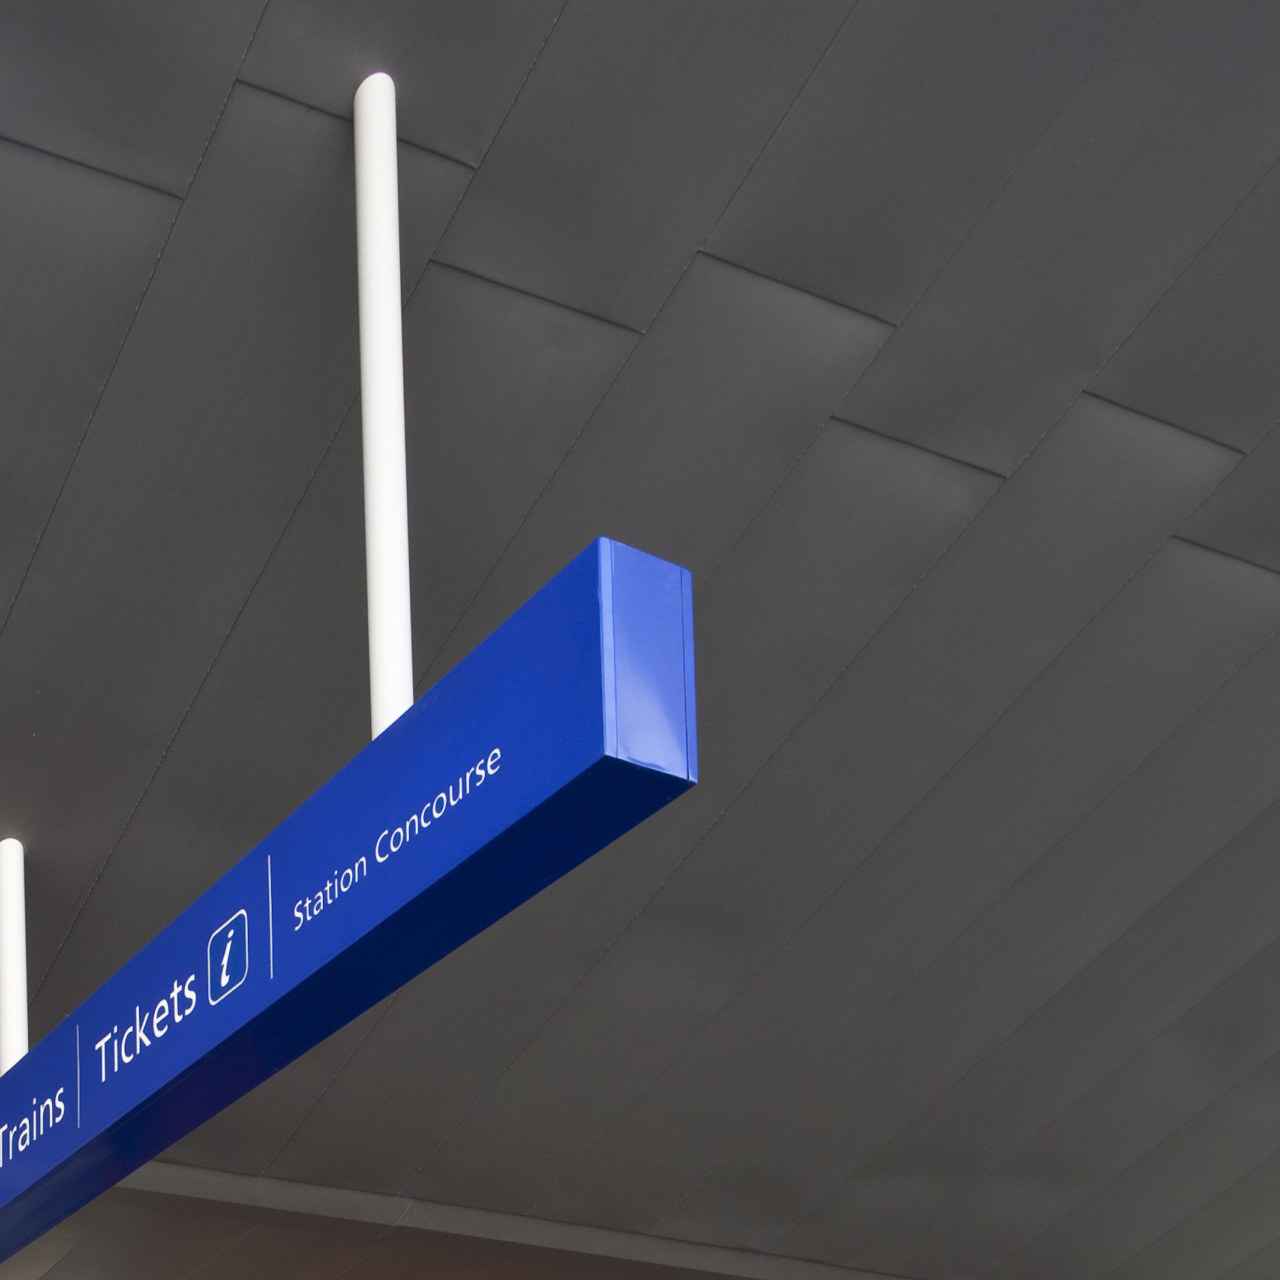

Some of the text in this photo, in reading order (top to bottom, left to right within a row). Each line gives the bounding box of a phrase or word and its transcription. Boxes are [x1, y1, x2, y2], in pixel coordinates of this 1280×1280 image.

[293, 747, 501, 931] Station Concourse
[94, 973, 197, 1083] Tickets
